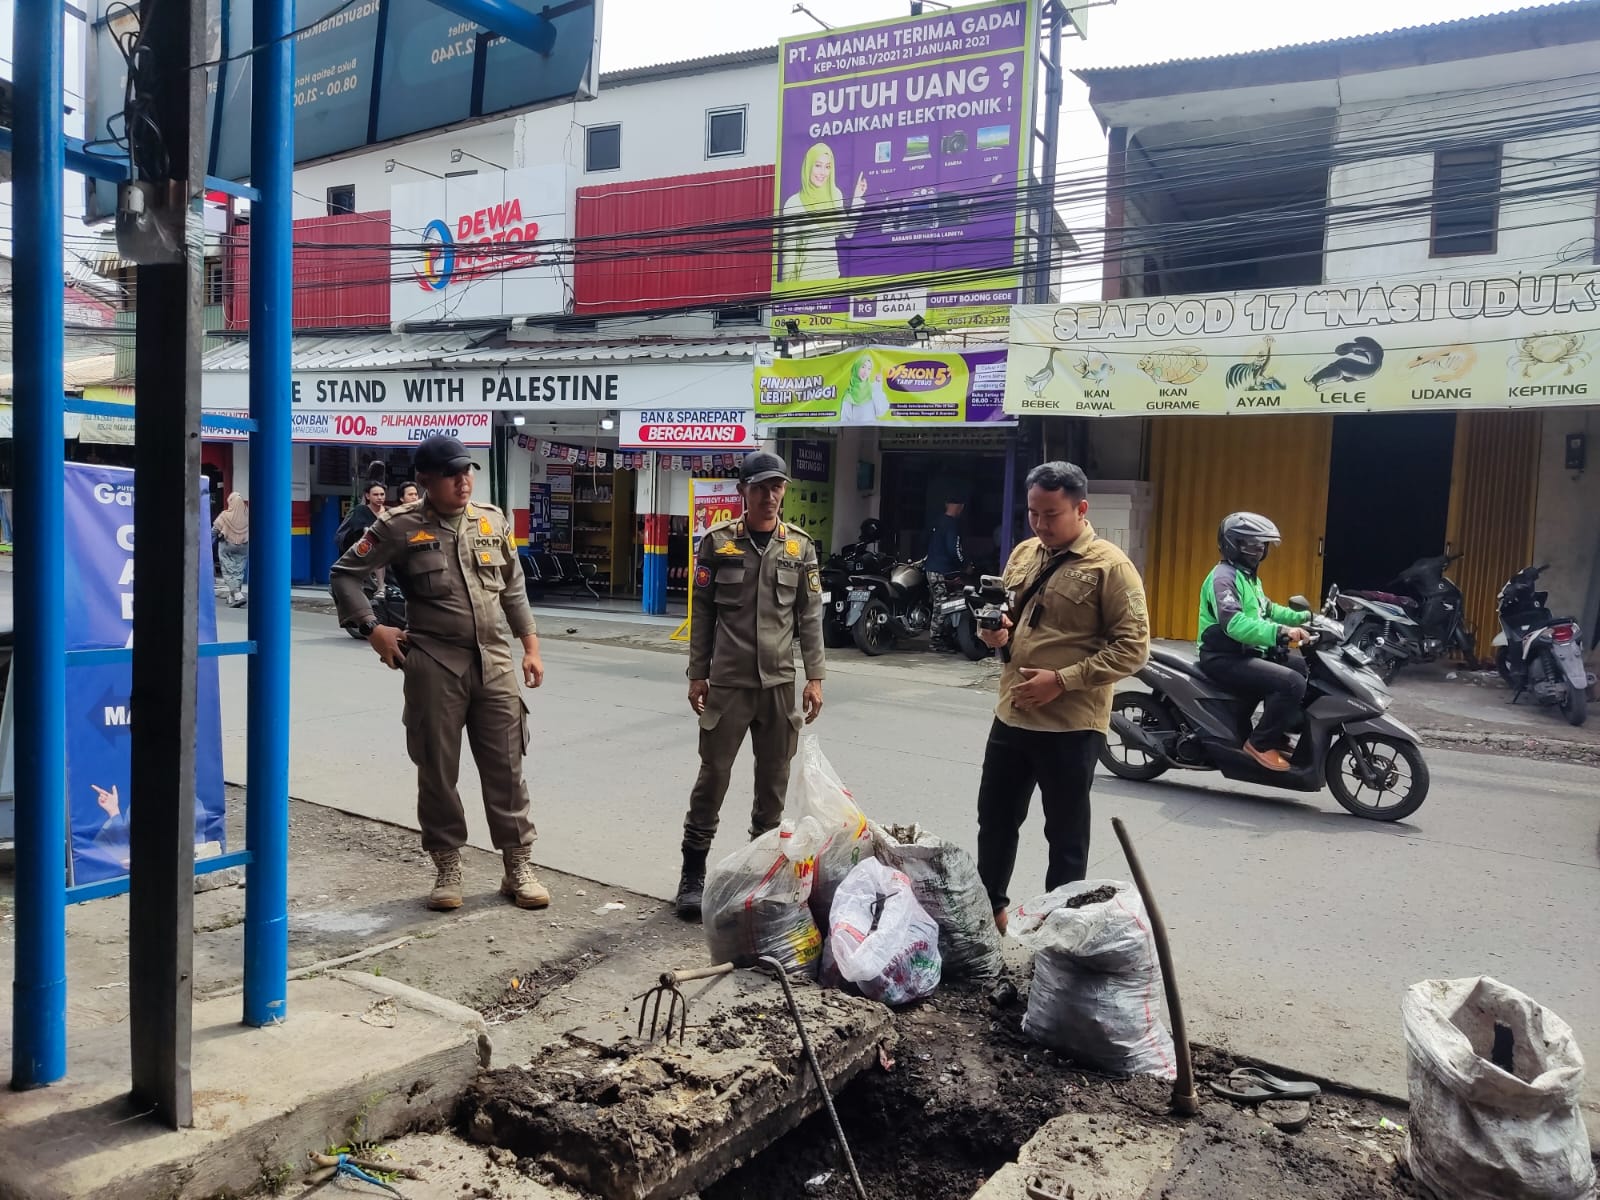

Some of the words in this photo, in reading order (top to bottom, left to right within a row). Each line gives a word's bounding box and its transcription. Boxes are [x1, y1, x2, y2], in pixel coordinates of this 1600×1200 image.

[789, 46, 811, 64] PT.
[816, 36, 888, 60] AMANAH
[894, 21, 956, 46] TERIMA
[962, 10, 1020, 33] GADAI
[903, 47, 913, 59] 21
[915, 39, 963, 56] JANUARI
[966, 35, 990, 48] 2021
[811, 80, 898, 116] BUTUH
[906, 66, 990, 102] UANG
[999, 61, 1015, 89] ?
[809, 113, 893, 138] GADAIKAN
[898, 97, 1001, 126] ELEKTRONIK
[1007, 95, 1012, 112] !
[458, 199, 522, 240] DEWA
[930, 295, 957, 304] OUTLET
[959, 294, 991, 302] BOJONG
[993, 292, 1012, 301] GEDE
[858, 303, 872, 313] RG
[882, 303, 916, 313] GADAI
[809, 316, 832, 326] 21.00
[1053, 297, 1234, 342] SEAFOOD
[1244, 293, 1298, 331] 17
[760, 375, 823, 389] PINJAMAN
[317, 379, 386, 403] STAND
[403, 378, 465, 403] WITH
[482, 374, 618, 402] PALESTINE
[760, 391, 793, 404] LEBIH
[796, 385, 837, 402] TINGGI
[1084, 389, 1110, 398] IKAN
[1159, 388, 1188, 397] IKAN
[1411, 388, 1472, 400] UDANG
[1508, 383, 1588, 398] KEPITING
[1236, 396, 1281, 408] AYAM
[1320, 392, 1366, 404] LELE
[1022, 400, 1060, 409] BEBEK
[1076, 401, 1116, 410] BAWAL
[1146, 400, 1200, 410] GURAME
[292, 415, 308, 425] KON
[310, 415, 328, 425] BAN
[381, 415, 421, 426] PILIHAN
[422, 415, 446, 426] BAN
[446, 415, 488, 427] MOTOR
[640, 411, 665, 423] BAN
[666, 411, 674, 423] &
[676, 410, 746, 424] SPAREPART
[648, 426, 736, 441] BERGARANSI
[475, 538, 491, 546] POL
